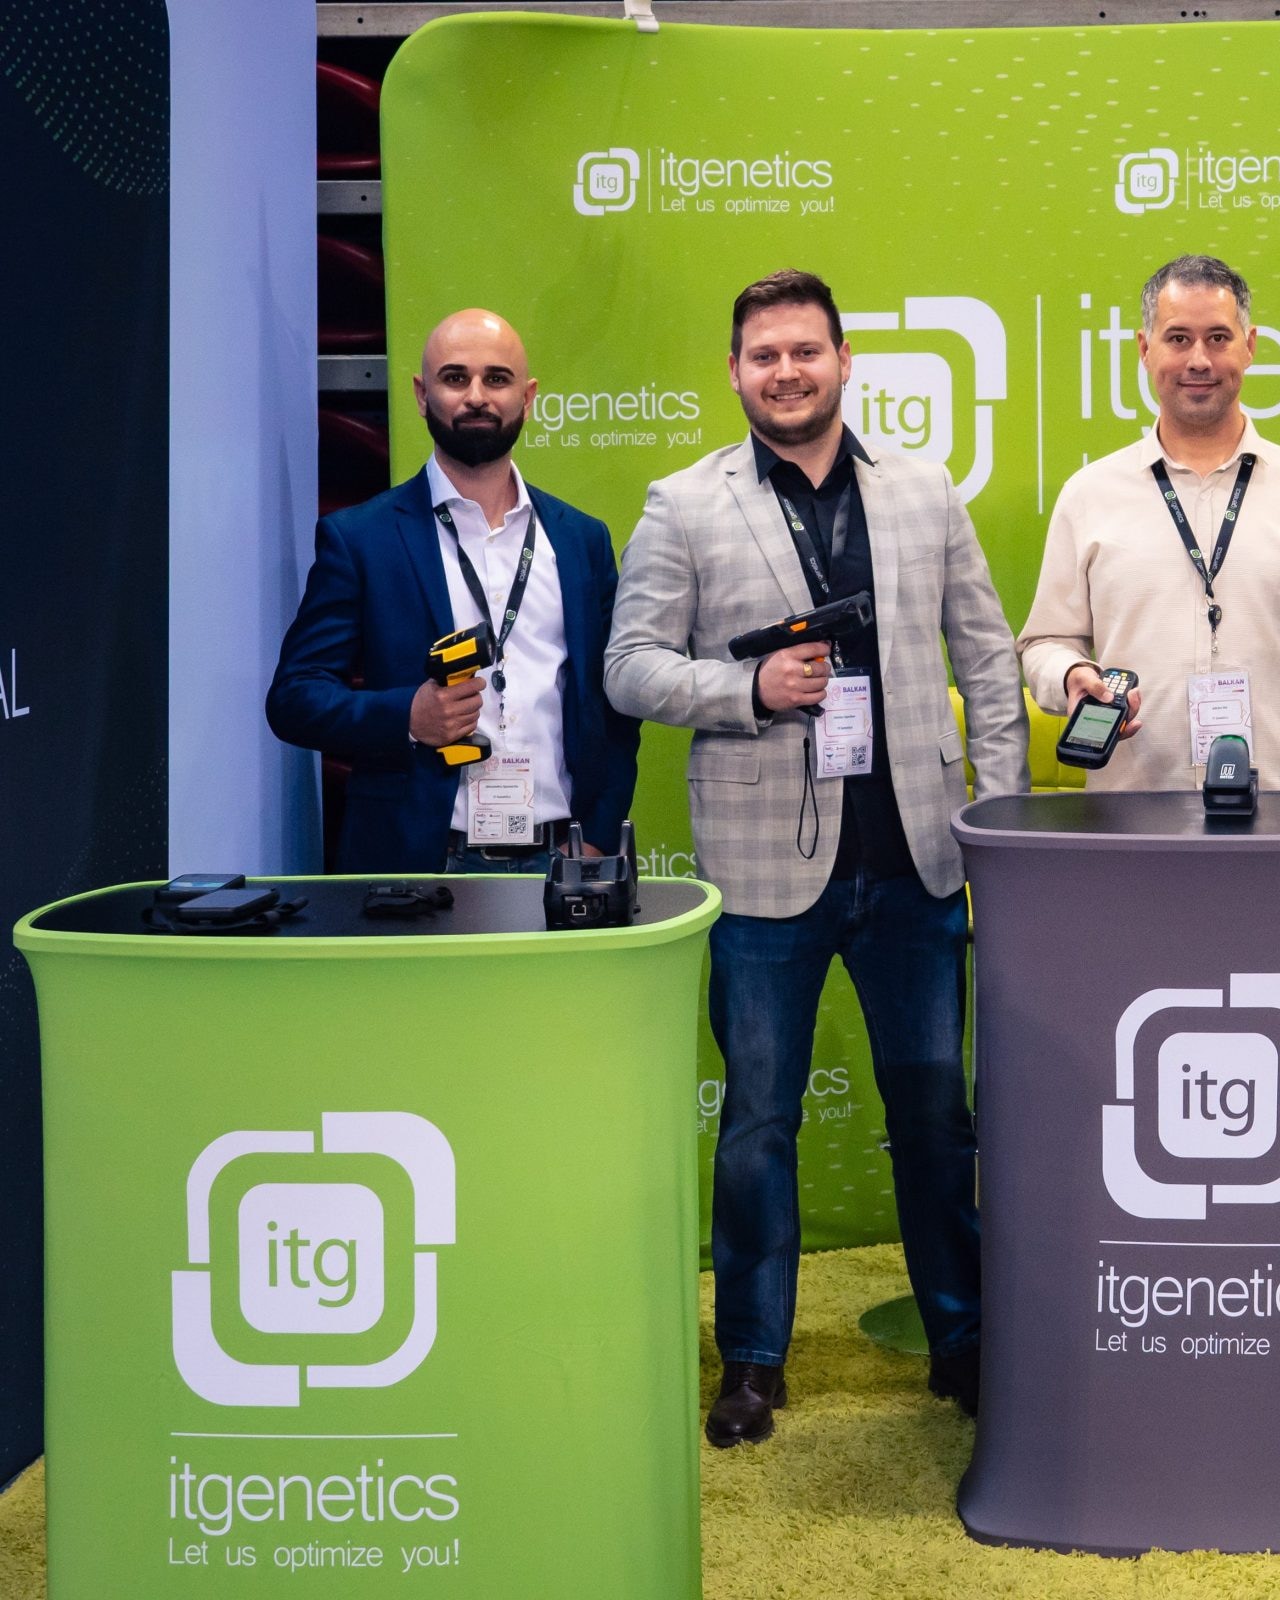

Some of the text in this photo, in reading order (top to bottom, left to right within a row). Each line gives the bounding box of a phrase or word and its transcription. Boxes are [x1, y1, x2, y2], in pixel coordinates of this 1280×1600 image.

[597, 174, 618, 193] itg
[660, 148, 833, 192] itgenetics
[1137, 173, 1158, 192] itg
[661, 195, 835, 216] Let us optimize you!
[1199, 191, 1223, 208] Let
[1233, 195, 1252, 208] us
[533, 382, 702, 432] tgenetics
[861, 383, 932, 450] itg
[525, 427, 702, 449] Let us optimize you!
[1217, 678, 1245, 686] BALKAN
[818, 1102, 853, 1125] you!
[1182, 1063, 1256, 1137] itg
[267, 1221, 357, 1308] itg
[1095, 1328, 1128, 1353] Let
[1142, 1335, 1167, 1354] us
[1181, 1331, 1271, 1360] optimize
[169, 1455, 460, 1537] itgenetics
[168, 1537, 460, 1573] Let us optimize you!
